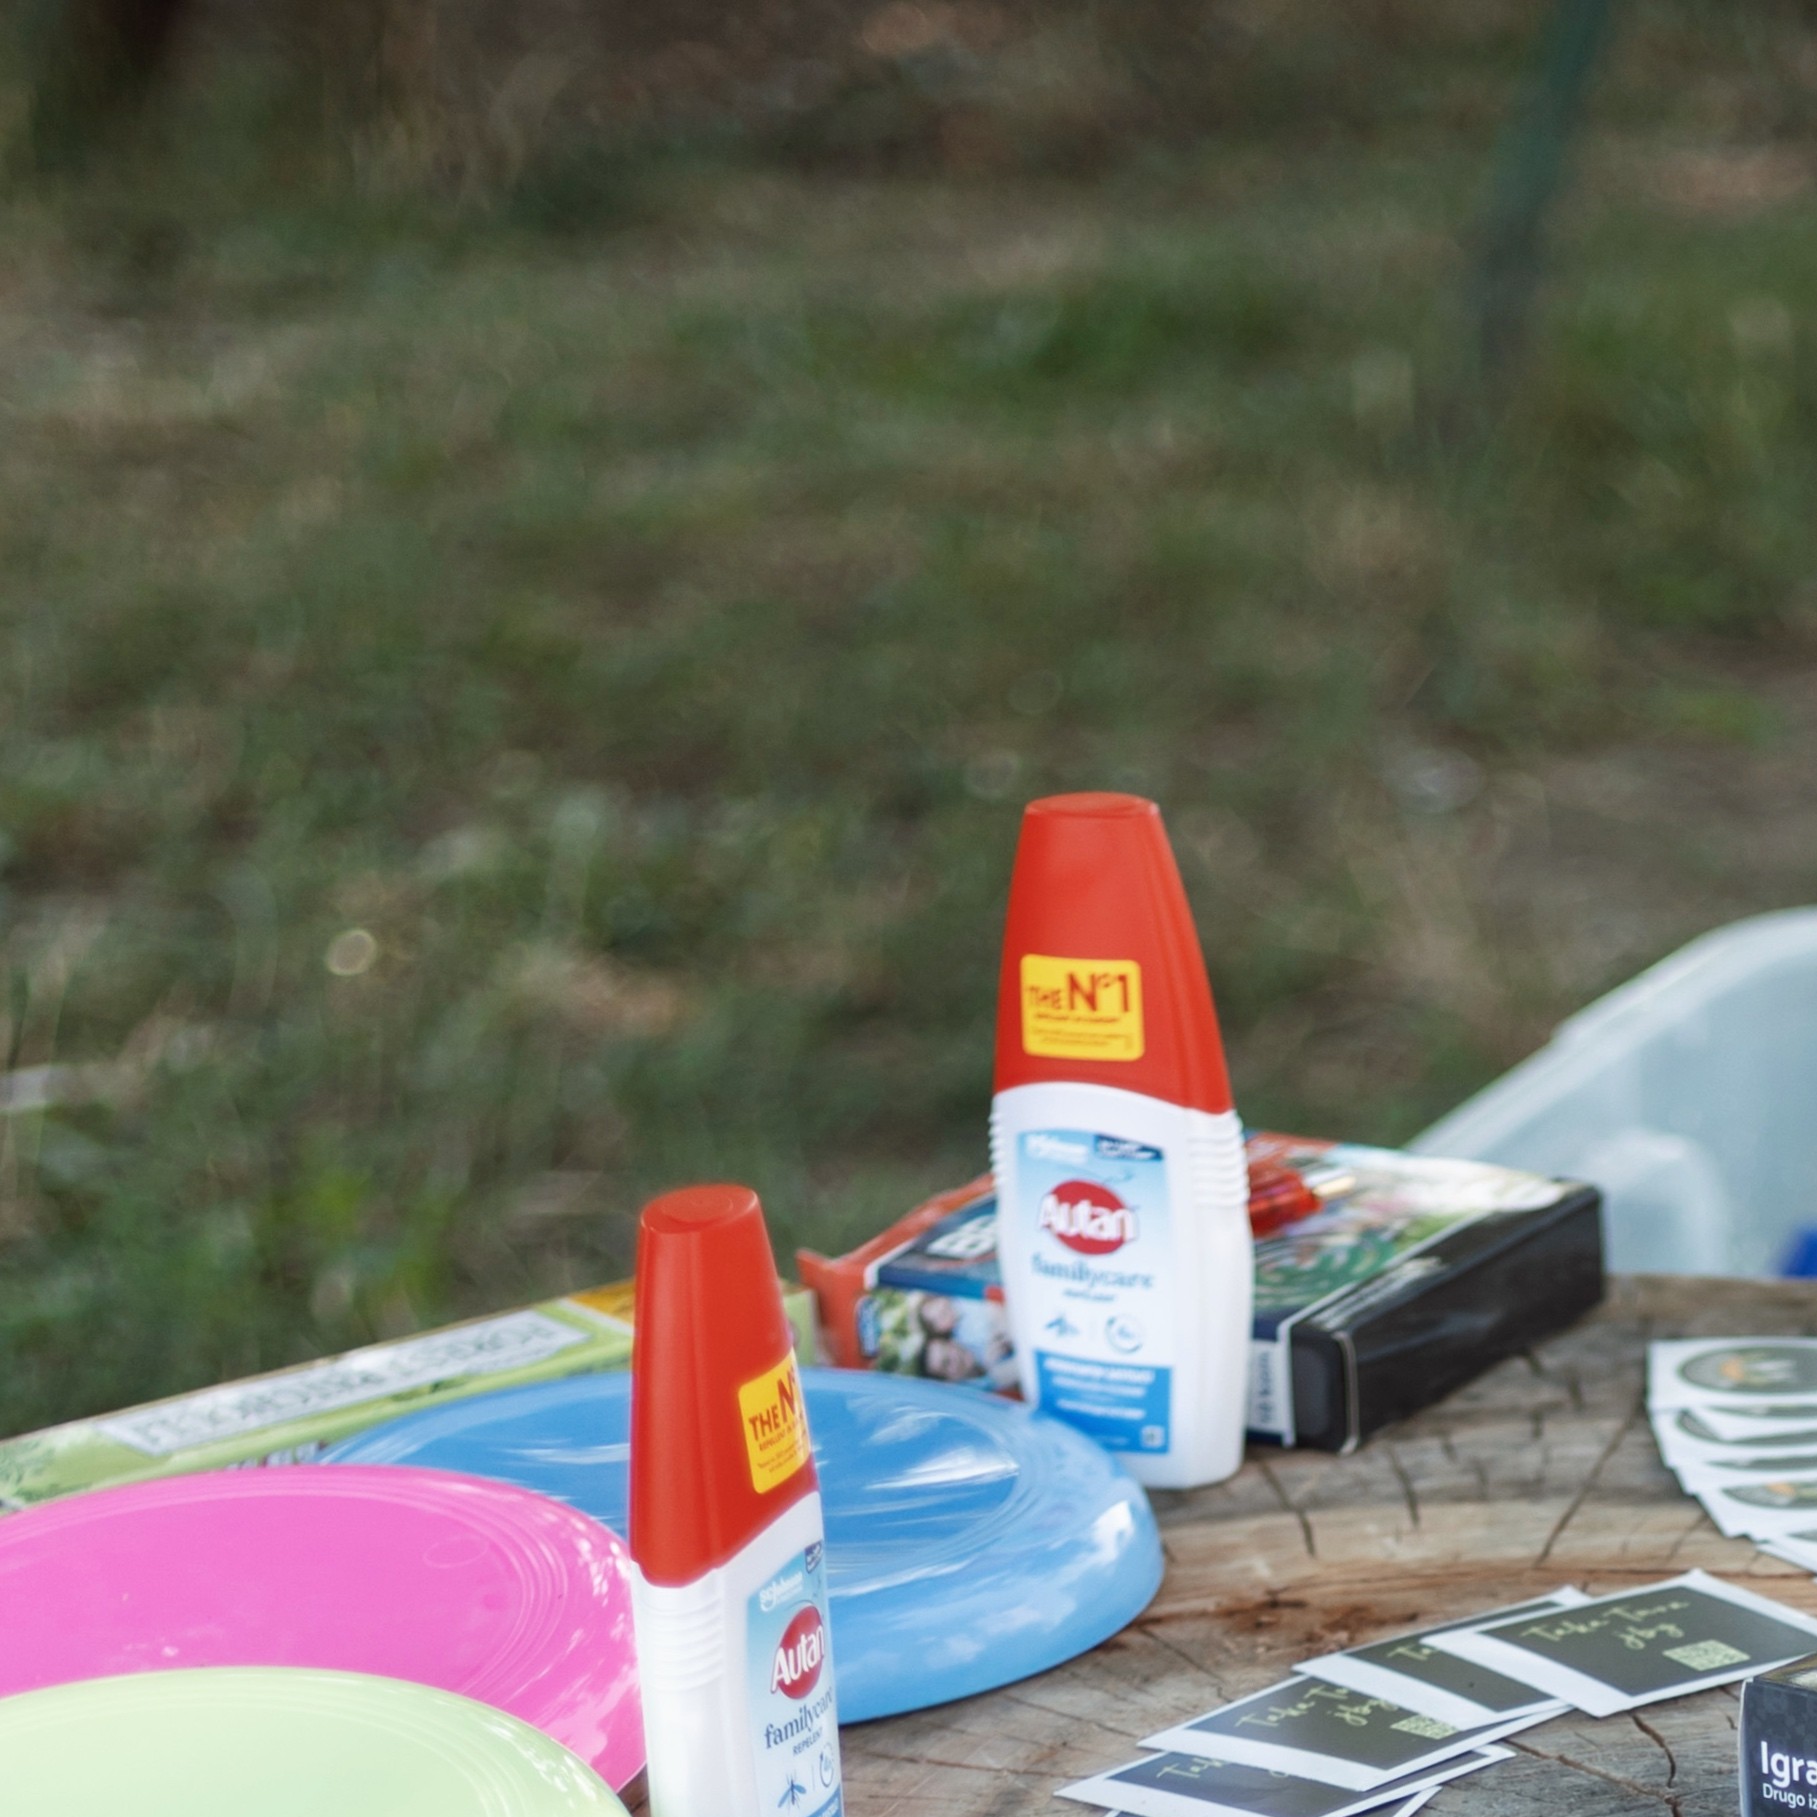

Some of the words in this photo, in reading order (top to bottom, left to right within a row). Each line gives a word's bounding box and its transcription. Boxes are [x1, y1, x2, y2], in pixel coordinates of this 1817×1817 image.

[1040, 1193, 1138, 1243] Autan
[749, 1404, 780, 1440] THE
[771, 1624, 825, 1693] Autan
[1762, 1783, 1805, 1808] Drugo
